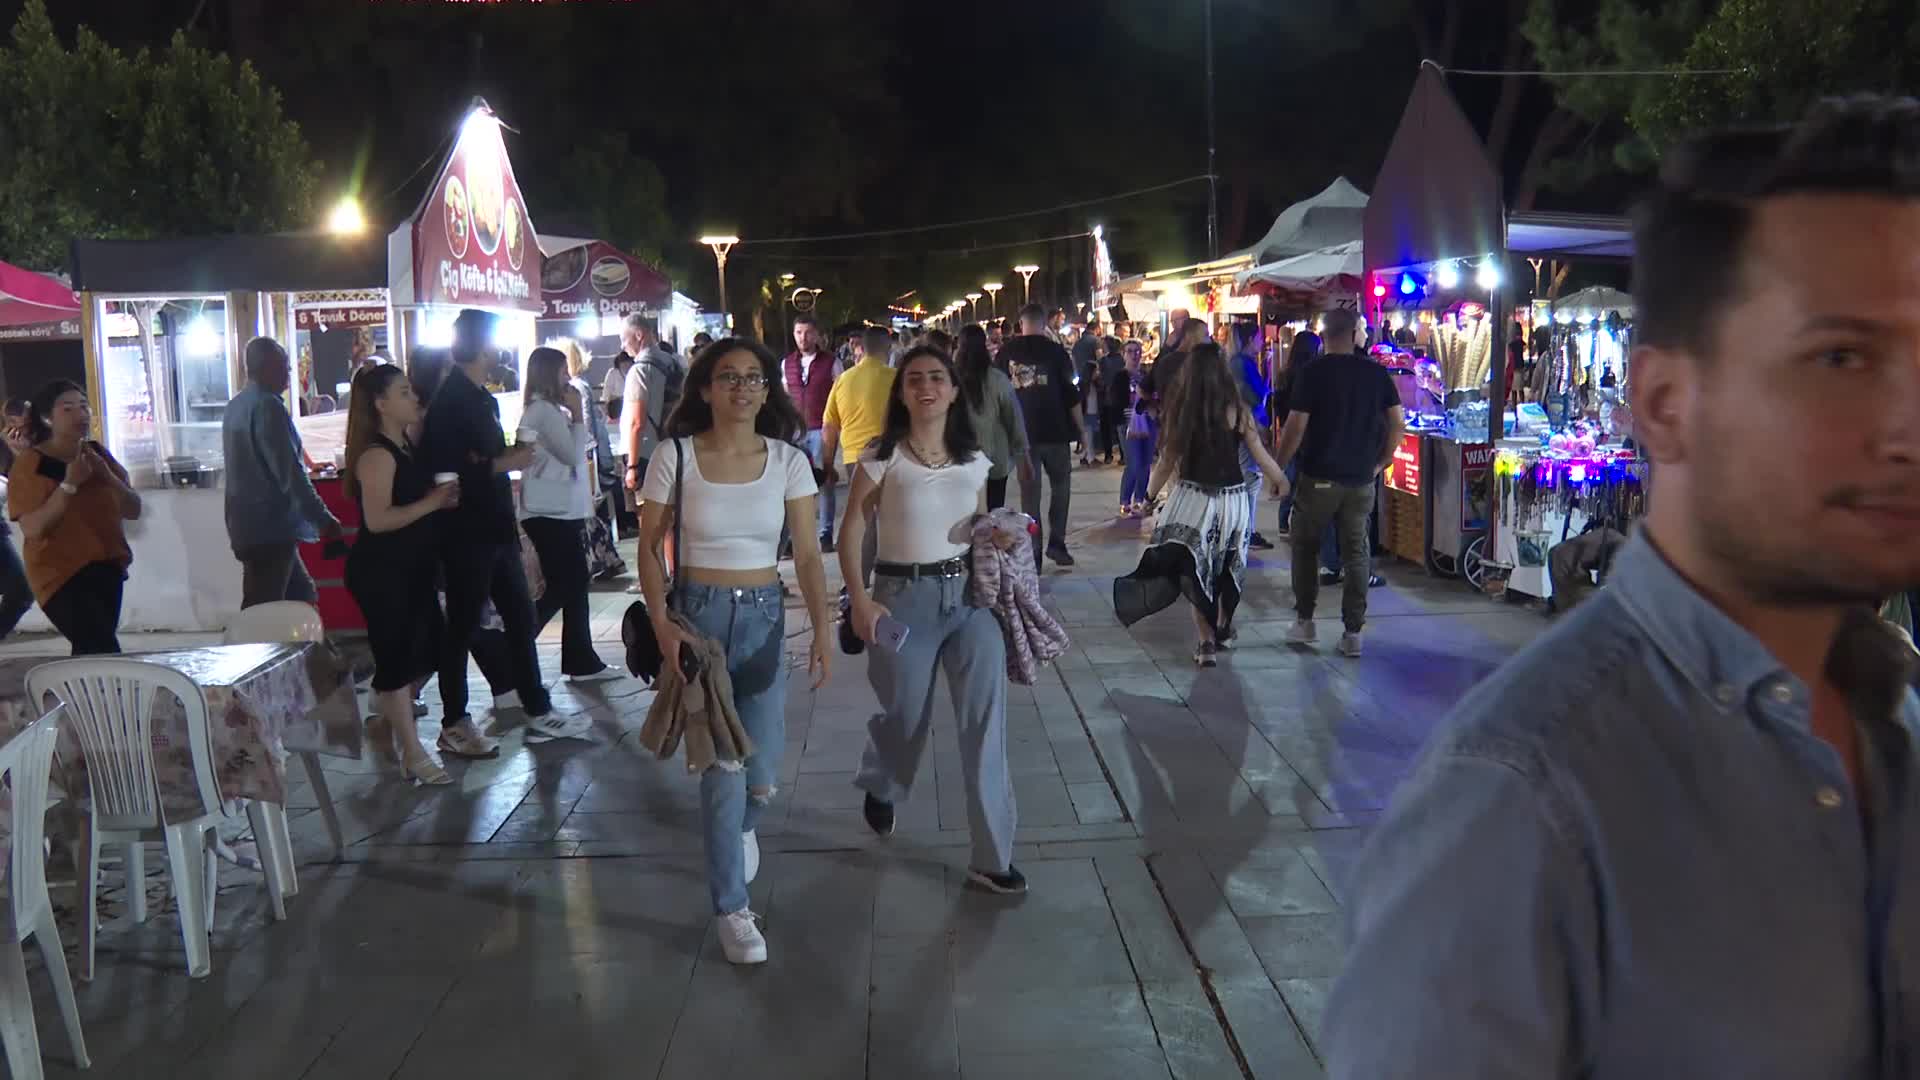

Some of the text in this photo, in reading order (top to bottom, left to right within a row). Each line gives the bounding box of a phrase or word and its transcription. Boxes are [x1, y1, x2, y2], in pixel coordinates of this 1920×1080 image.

[460, 262, 486, 291] Köfte
[311, 306, 346, 323] Tavuk
[349, 309, 386, 322] Döner
[552, 299, 595, 314] Tavuk
[599, 299, 647, 313] Döner
[60, 320, 80, 335] Su
